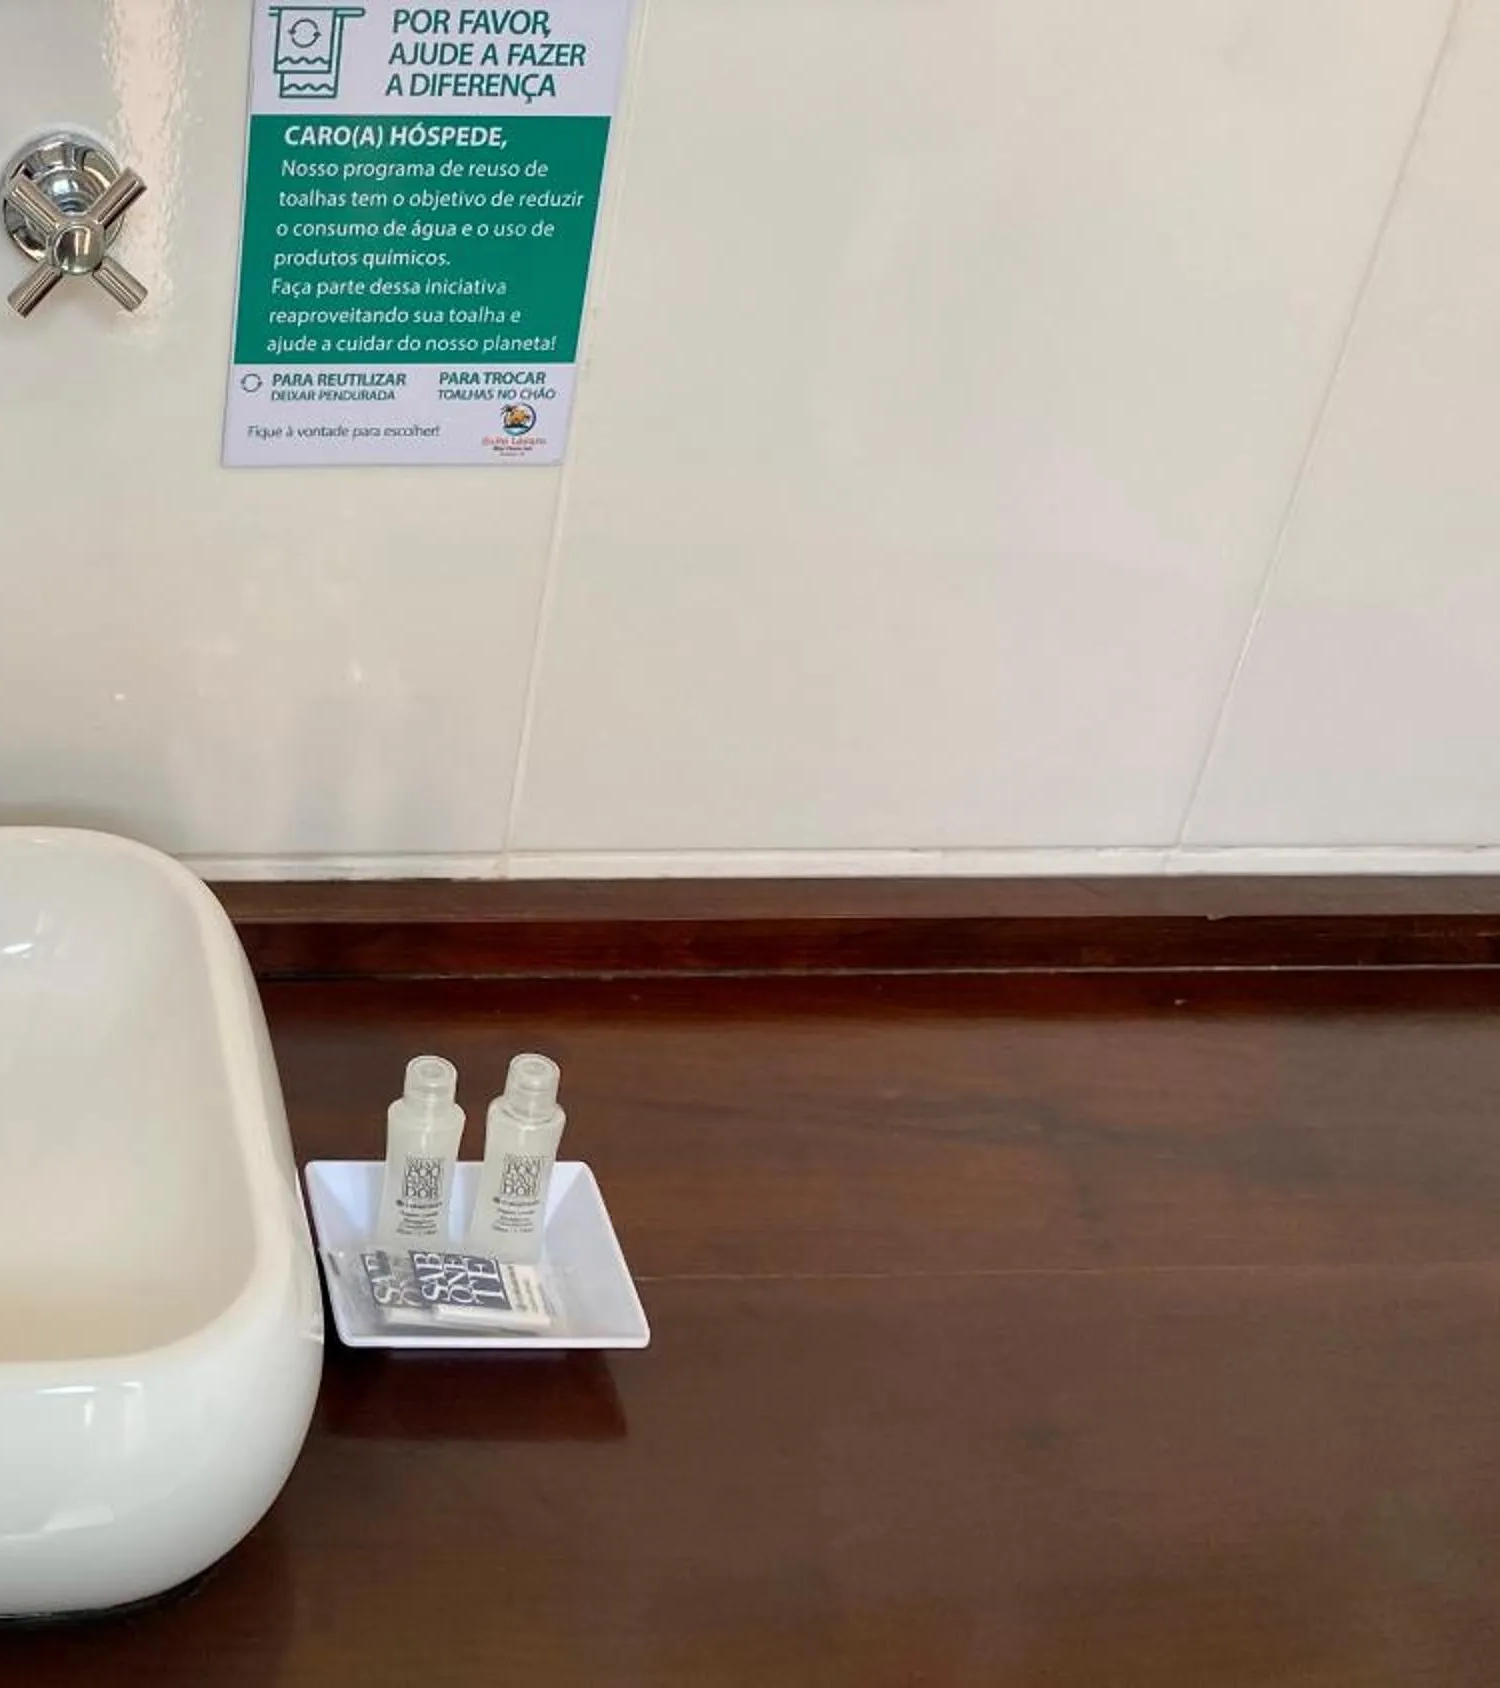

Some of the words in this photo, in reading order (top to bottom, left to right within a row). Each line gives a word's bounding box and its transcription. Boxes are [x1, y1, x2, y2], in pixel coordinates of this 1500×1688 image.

[393, 10, 450, 34] POR
[458, 10, 551, 37] FAVOR,
[388, 43, 474, 66] AJUDE
[481, 44, 498, 66] A
[507, 43, 586, 67] FAZER
[385, 74, 402, 97] A
[409, 74, 556, 103] DIFERENÇA
[284, 125, 383, 149] CARO(A)
[389, 122, 507, 149] HÓSPEDE,
[281, 160, 339, 177] Nosso
[343, 163, 435, 182] programa
[440, 160, 462, 177] de
[468, 163, 520, 177] reuso
[524, 160, 548, 177] de
[279, 191, 346, 207] toalhas
[351, 193, 387, 207] tem
[392, 195, 405, 207] o
[409, 190, 486, 213] objetivo
[491, 190, 513, 207] de
[518, 190, 584, 207] reduzir
[276, 224, 288, 236] o
[293, 224, 378, 236] consumo
[383, 220, 406, 236] de
[410, 220, 457, 242] água
[461, 224, 473, 236] e
[478, 224, 489, 236] o
[494, 224, 526, 236] uso
[530, 220, 554, 236] de
[273, 250, 358, 270] produtos
[362, 250, 451, 270] químicos.
[271, 279, 311, 298] Faça
[316, 281, 365, 298] parte
[369, 279, 421, 294] dessa
[425, 279, 507, 294] iniciativa
[269, 307, 408, 327] reaproveitando
[413, 311, 444, 323] sua
[449, 307, 505, 323] toalha
[510, 311, 521, 323] e
[267, 335, 316, 353] ajude
[321, 339, 332, 351] a
[336, 335, 393, 351] cuidar
[397, 335, 421, 351] do
[425, 339, 478, 351] nosso
[483, 335, 557, 352] planeta!
[272, 373, 313, 386] PARA
[317, 373, 406, 386] REUTILIZAR
[439, 372, 479, 385] PARA
[483, 372, 546, 385] TROCAR
[271, 389, 313, 400] DEIXAR
[315, 389, 395, 400] PENDURADA
[437, 389, 495, 400] TOALHAS
[498, 389, 517, 400] NO
[519, 387, 556, 399] CHÃO
[248, 425, 282, 439] Fique
[285, 425, 294, 437] à
[297, 425, 349, 437] vontade
[352, 428, 379, 440] para
[384, 425, 440, 437] escolher!
[413, 1253, 450, 1302] SAB
